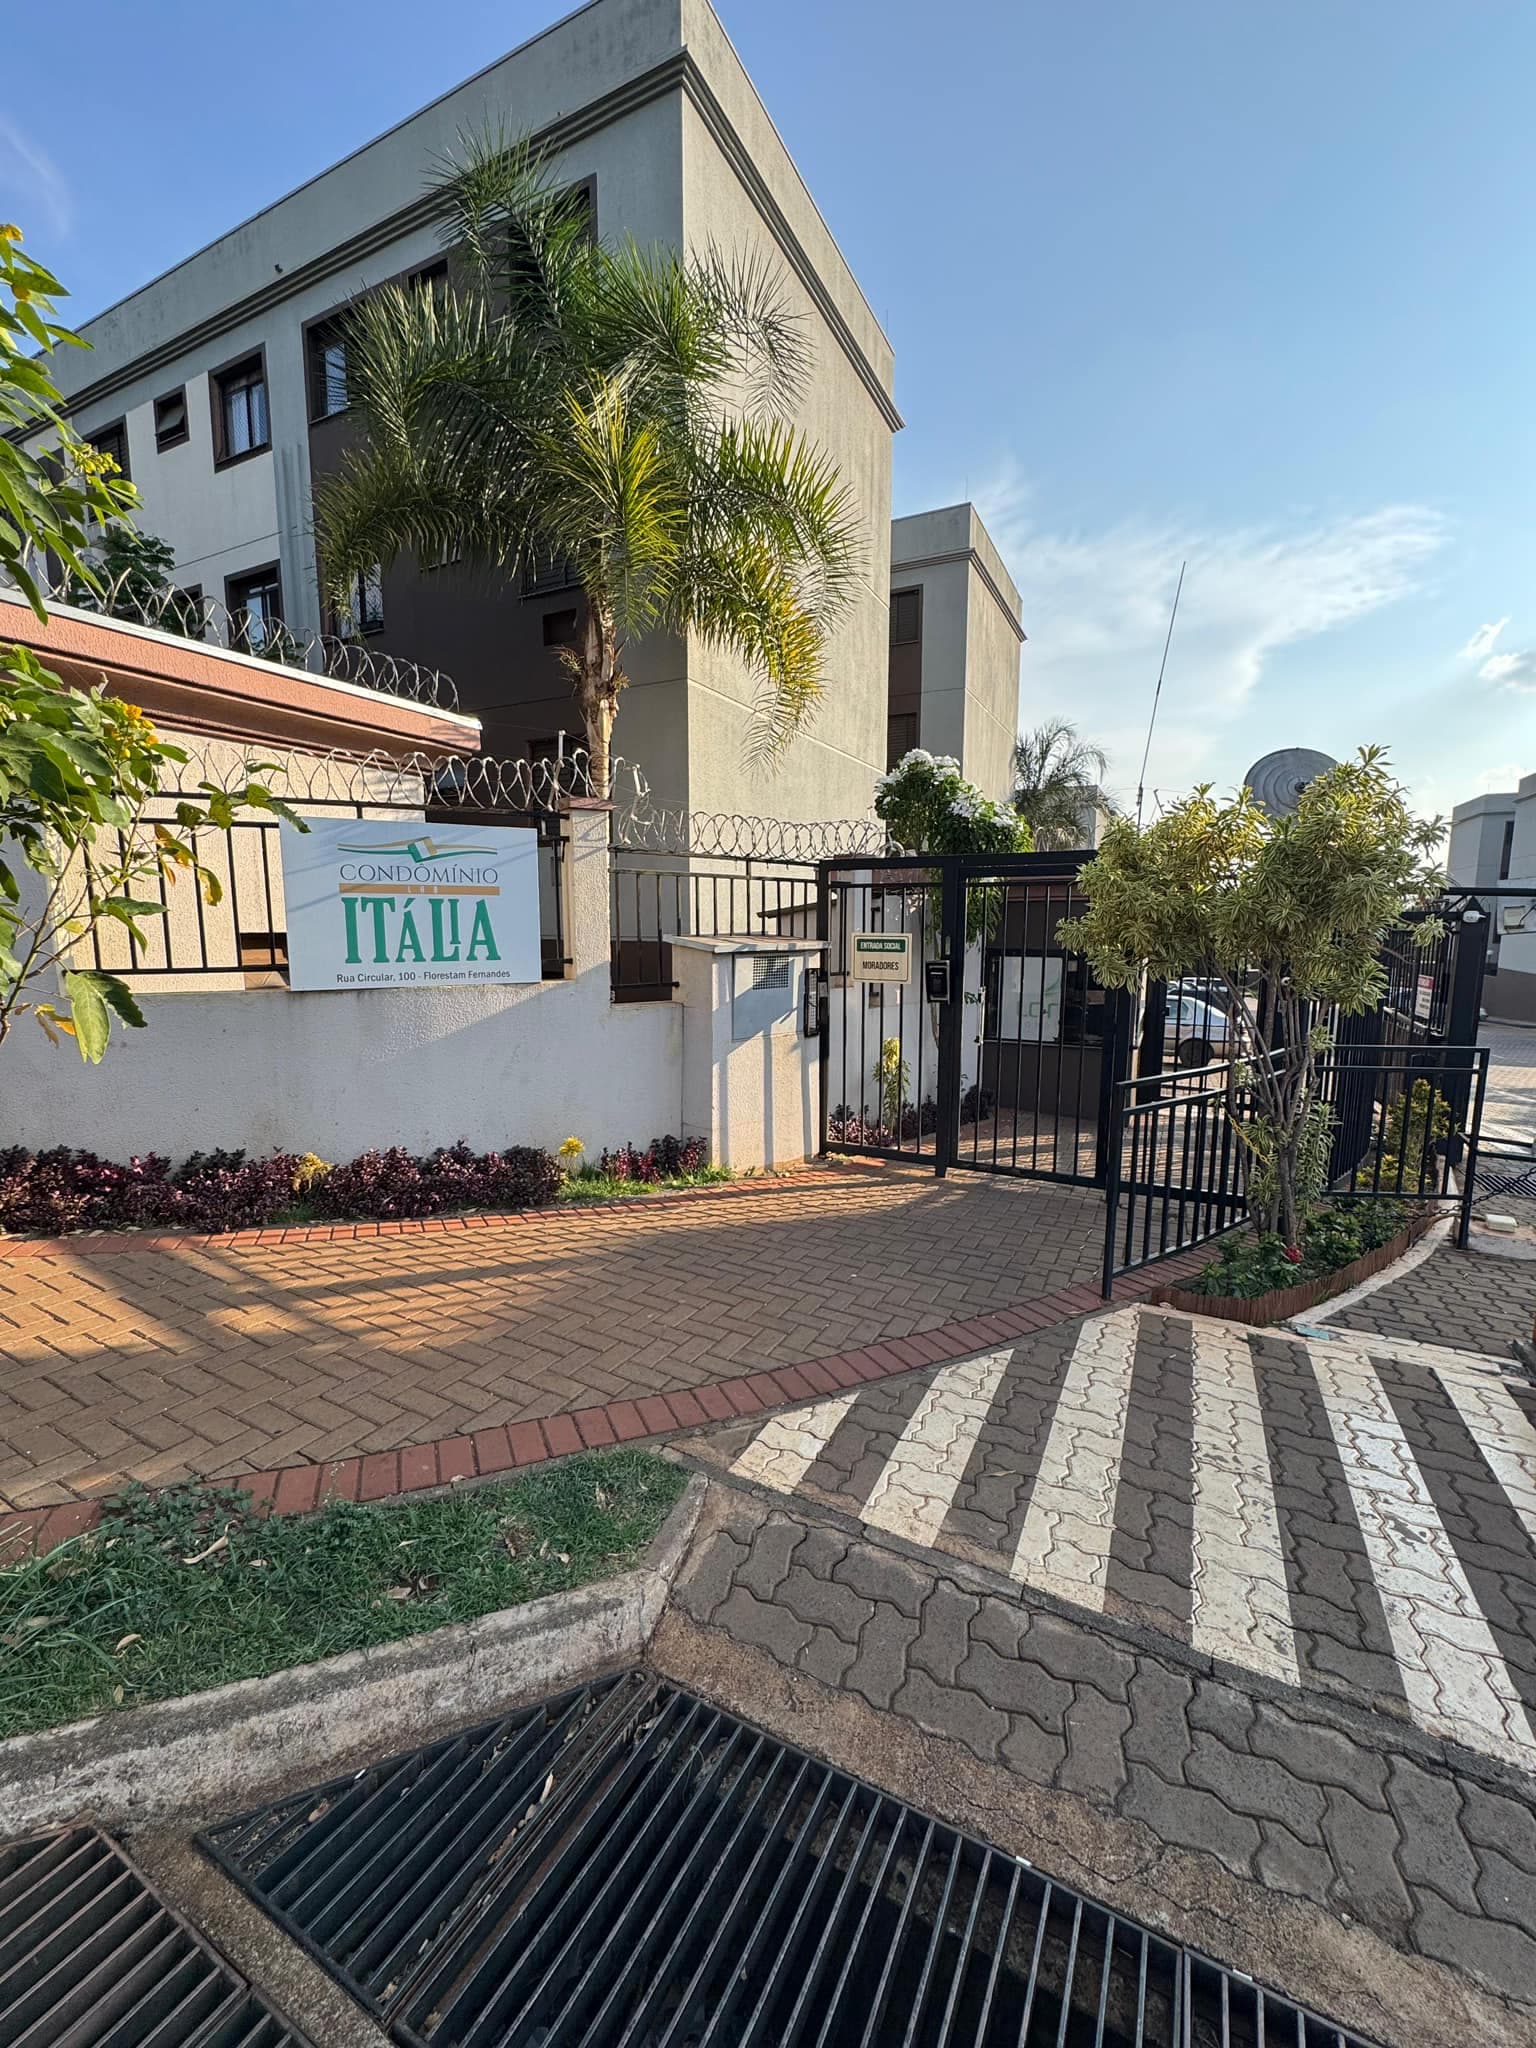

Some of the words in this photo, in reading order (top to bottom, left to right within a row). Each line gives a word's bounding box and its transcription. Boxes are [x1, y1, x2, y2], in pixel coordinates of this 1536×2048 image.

[341, 896, 502, 964] ITÁLIA
[860, 941, 882, 949] ENTRADA
[884, 942, 901, 950] SOCIAL
[862, 961, 899, 970] MORADORES
[336, 973, 355, 983] Rua
[357, 972, 396, 982] Circular,
[399, 972, 416, 981] 100
[423, 971, 465, 980] Florestam
[468, 970, 511, 979] Fernandes
